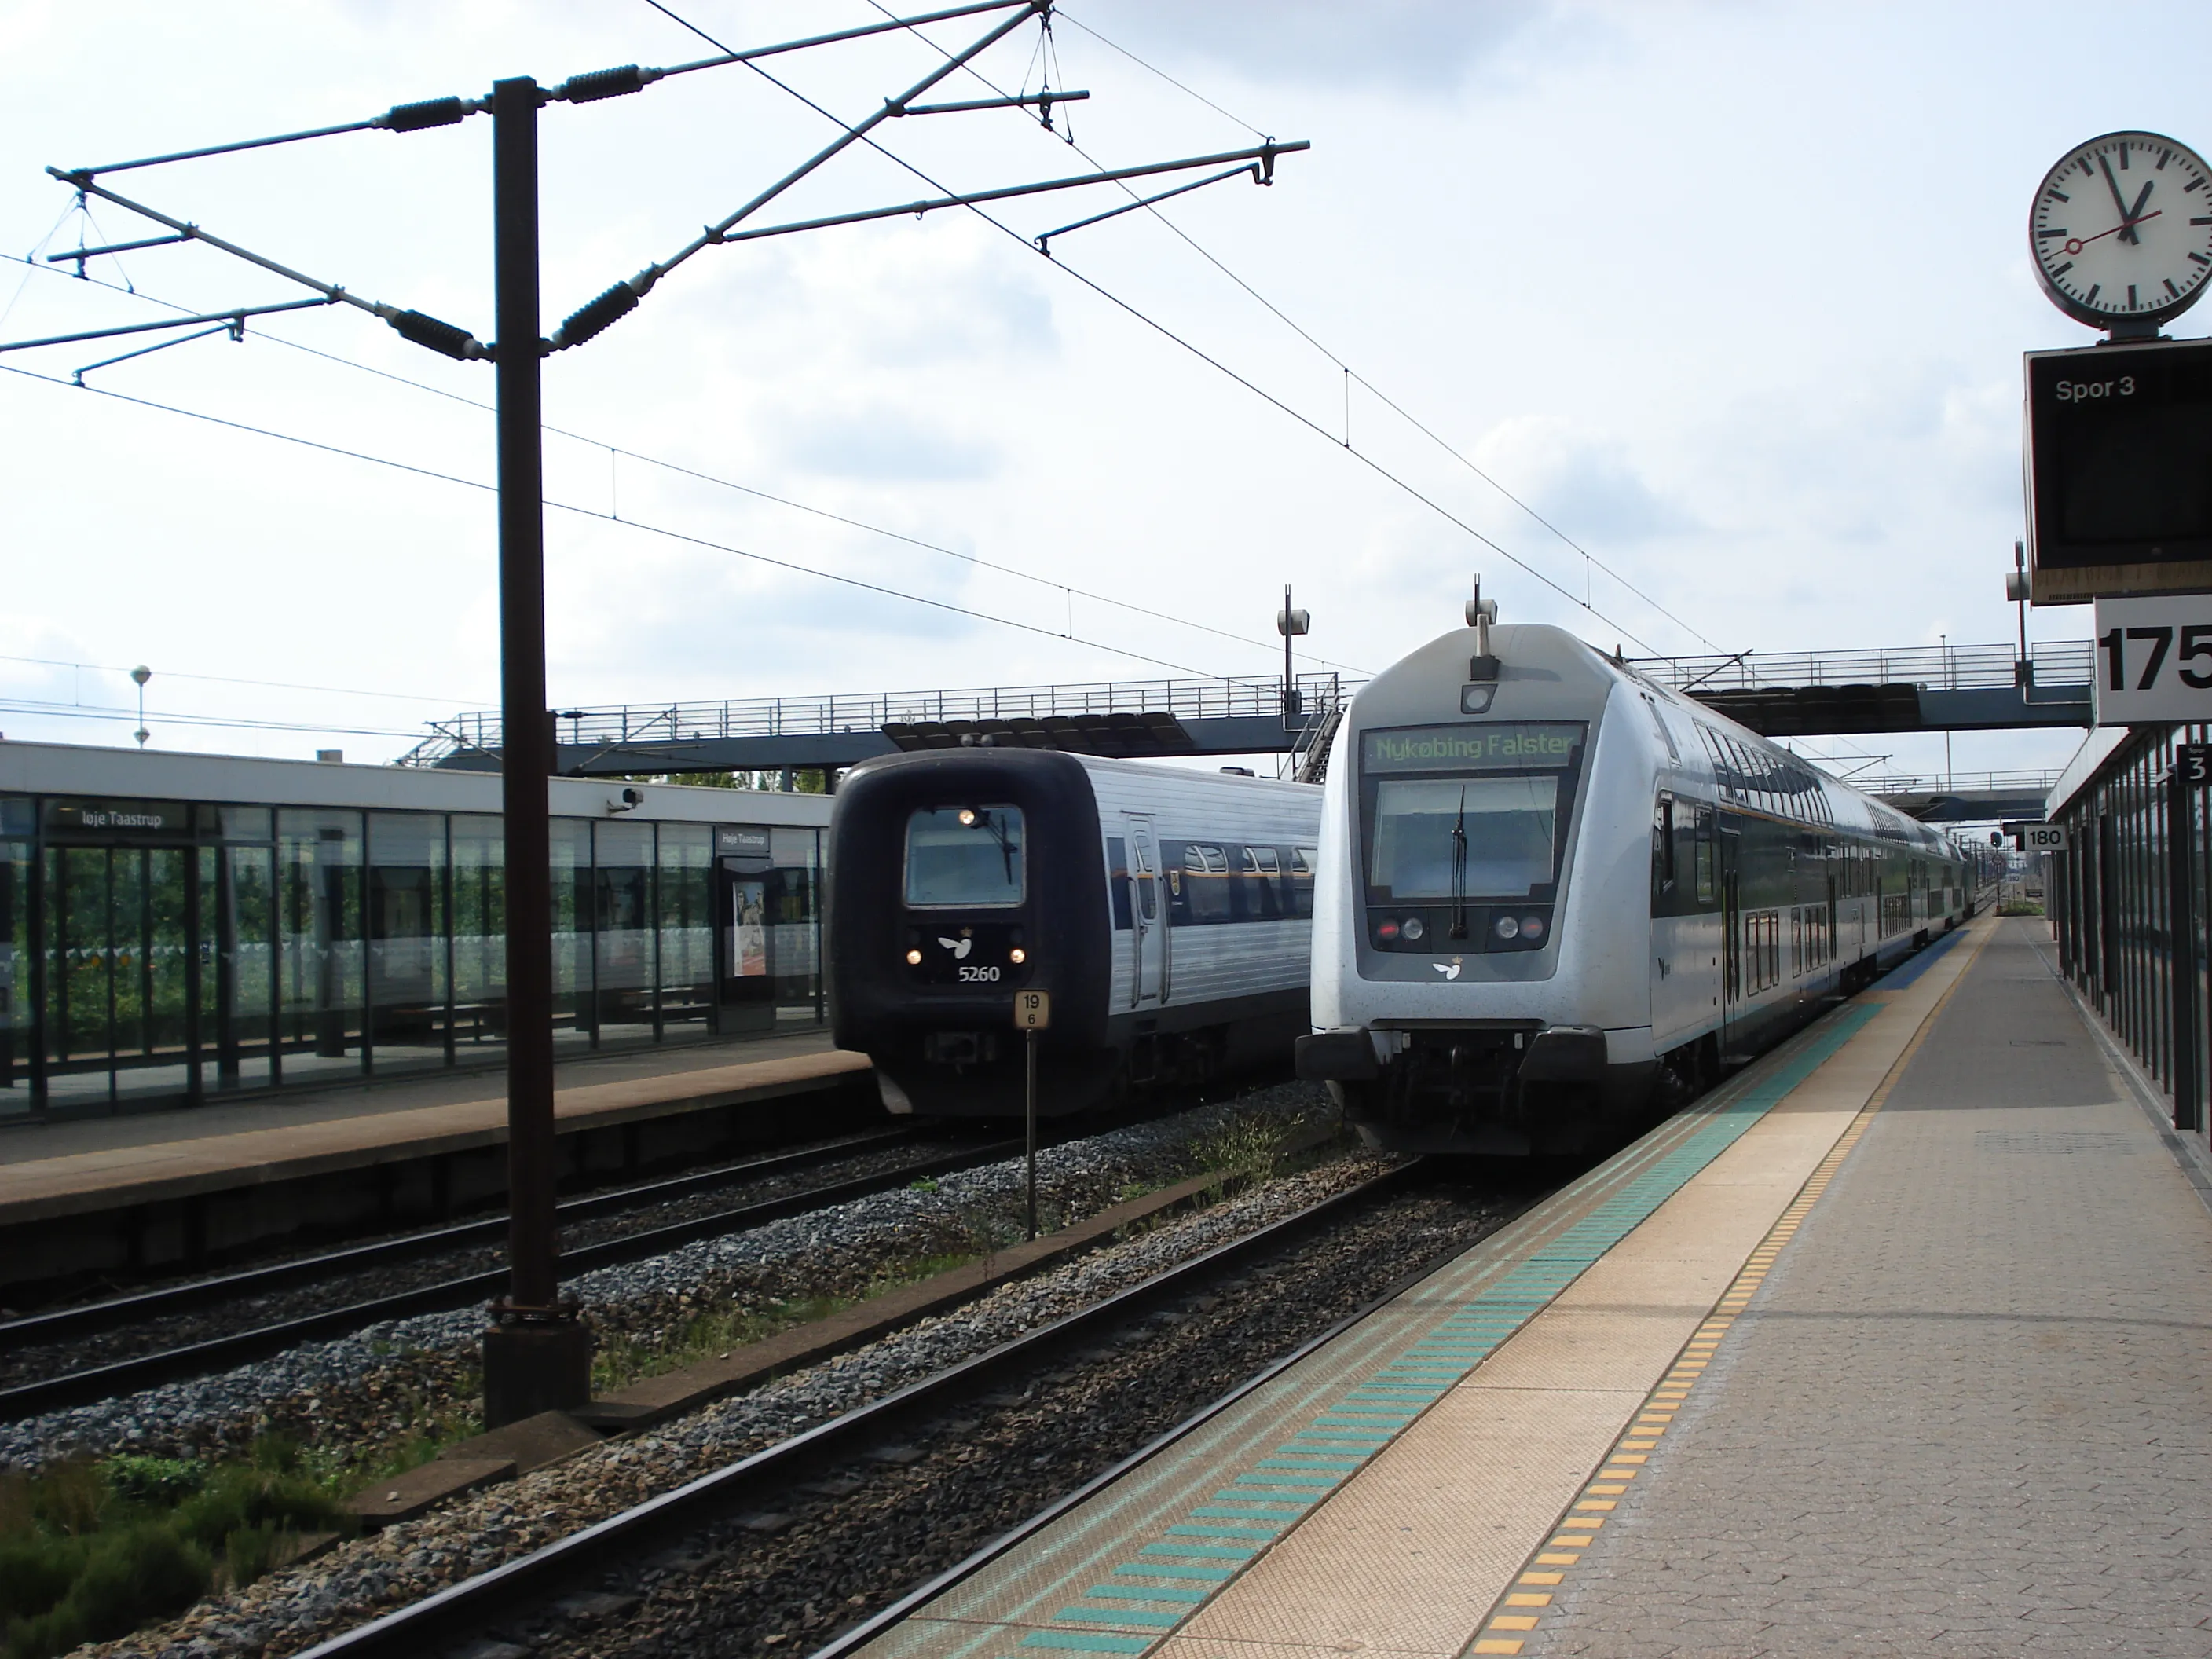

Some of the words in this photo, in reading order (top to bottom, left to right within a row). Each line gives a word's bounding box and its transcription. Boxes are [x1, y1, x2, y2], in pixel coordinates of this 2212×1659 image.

[2056, 380, 2115, 403] Spor
[2119, 375, 2136, 396] 3
[2098, 624, 2212, 691] 175
[1376, 735, 1482, 762] Nykøbing
[1487, 733, 1573, 756] Falster
[2189, 756, 2206, 780] 3
[108, 811, 162, 830] Taastrup
[2030, 830, 2061, 845] 180
[958, 966, 1001, 982] 5260
[1024, 994, 1040, 1009] 19
[1027, 1014, 1036, 1025] 6
